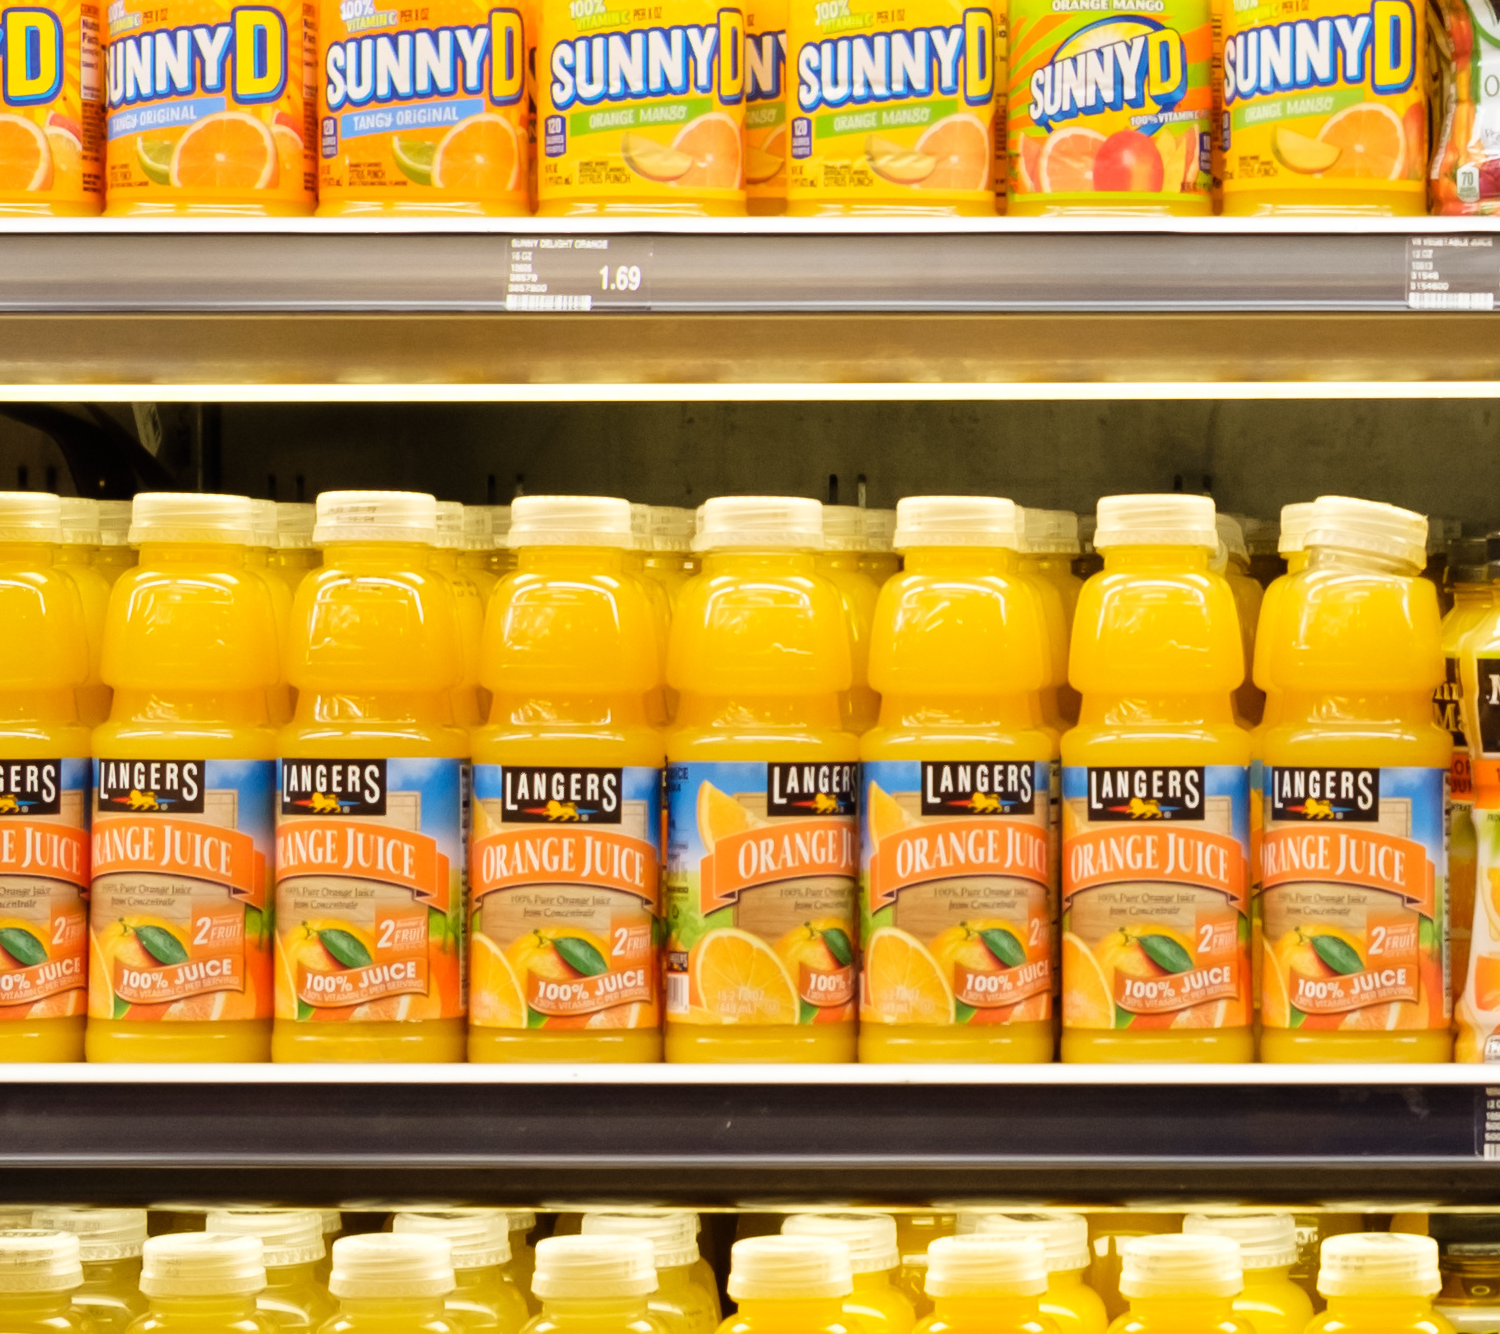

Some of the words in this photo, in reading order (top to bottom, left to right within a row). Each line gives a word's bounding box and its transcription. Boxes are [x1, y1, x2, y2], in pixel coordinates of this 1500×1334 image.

[353, 108, 402, 132] TANGY
[599, 265, 641, 291] 1.69
[23, 827, 82, 876] JUICE
